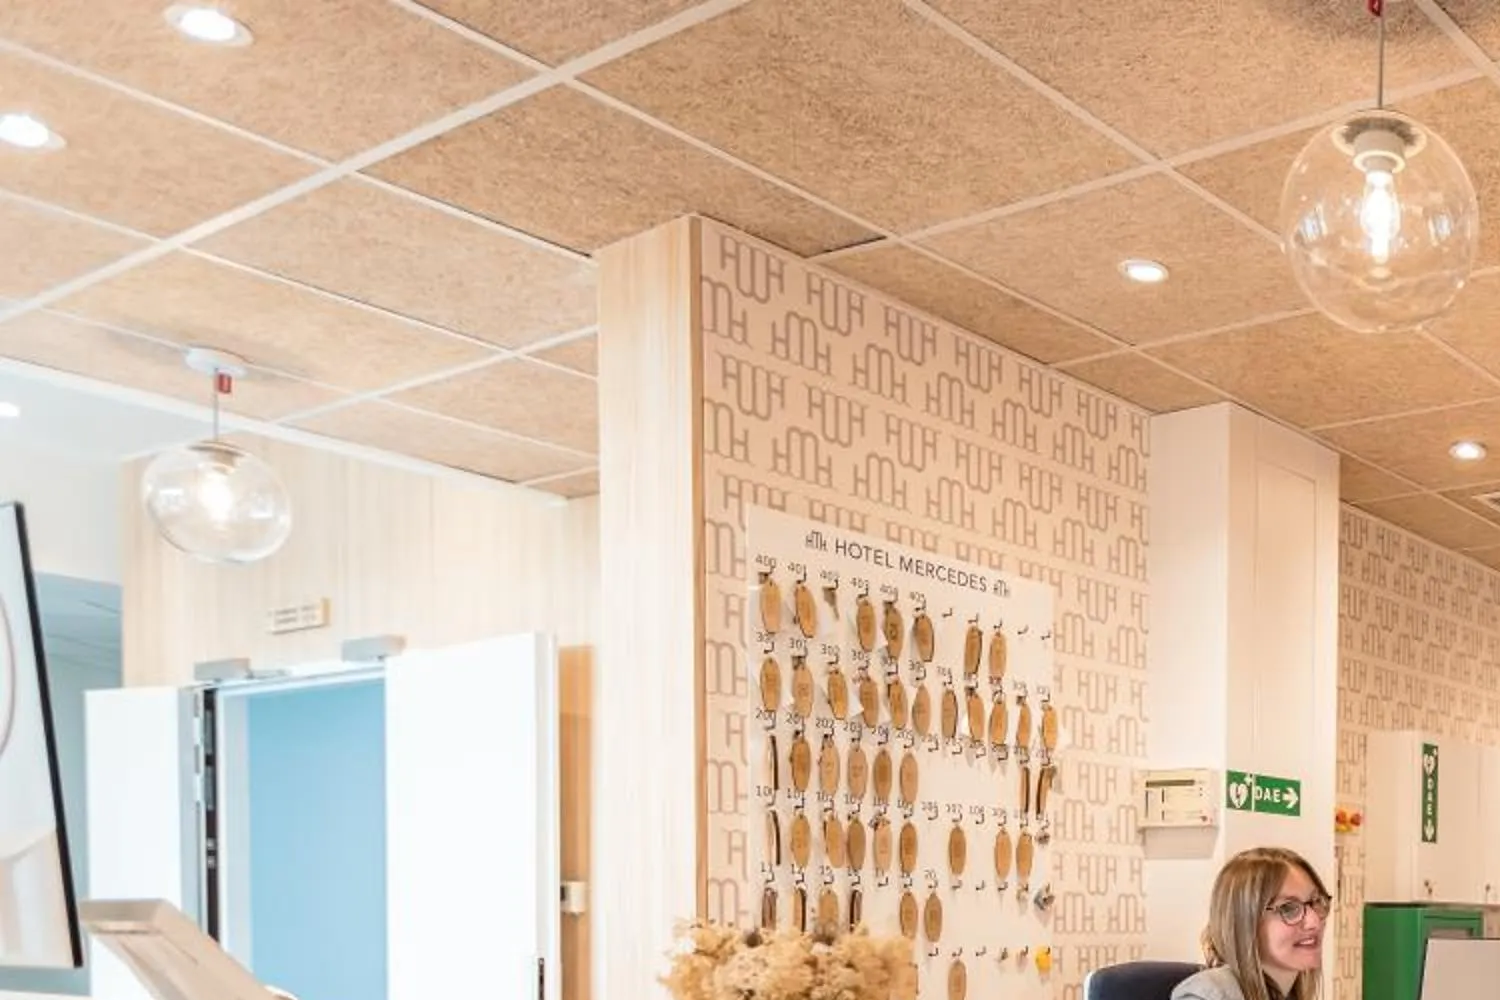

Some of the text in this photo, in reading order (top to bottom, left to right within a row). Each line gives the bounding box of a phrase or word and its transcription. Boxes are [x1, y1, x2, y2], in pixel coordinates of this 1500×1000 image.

[835, 538, 988, 593] HOTEL MERCEDES
[1254, 784, 1281, 803] DAE
